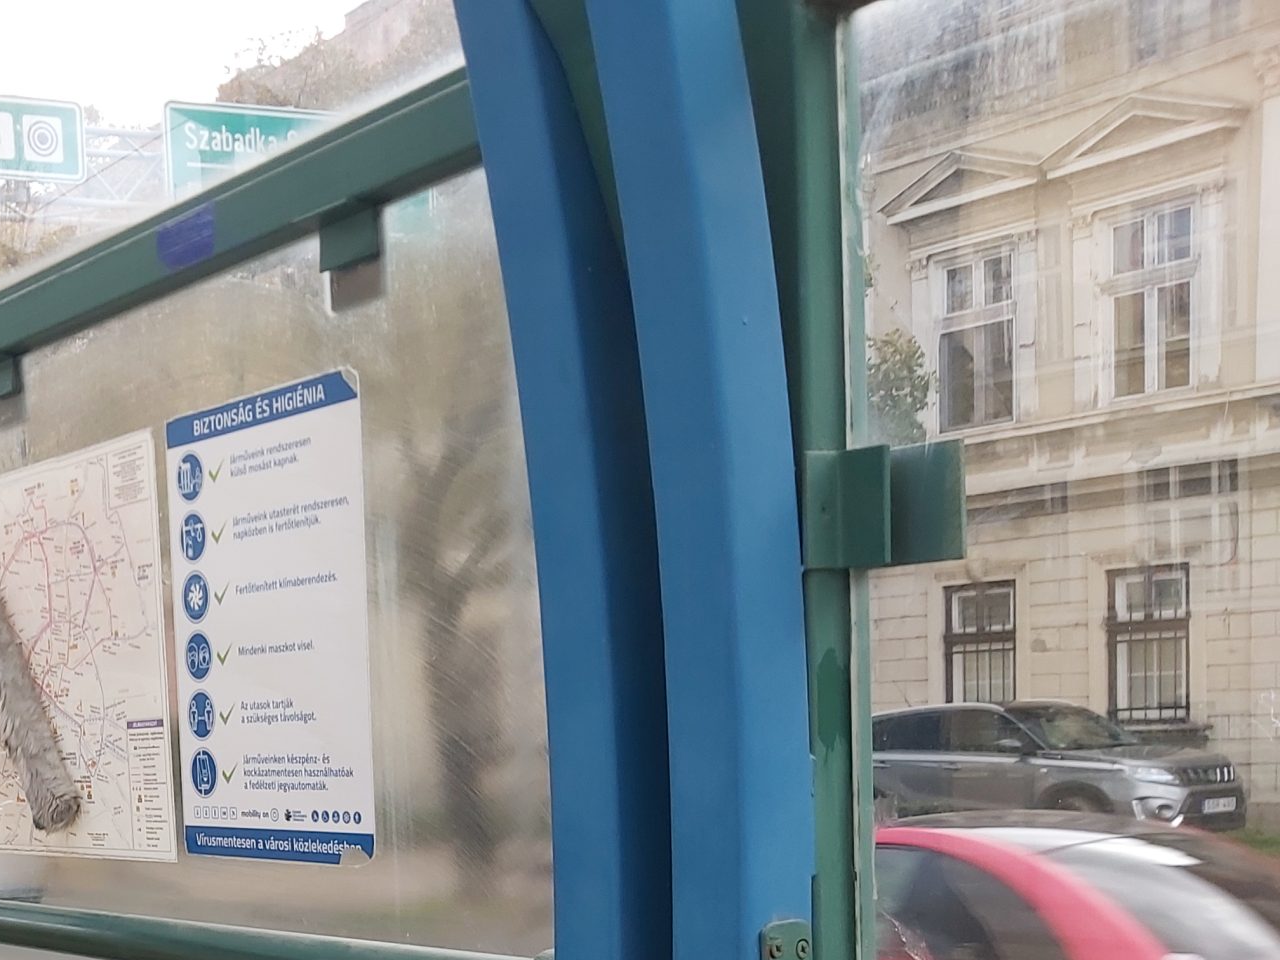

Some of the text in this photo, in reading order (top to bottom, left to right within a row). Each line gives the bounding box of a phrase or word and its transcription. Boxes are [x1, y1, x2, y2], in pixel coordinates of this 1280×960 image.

[193, 384, 325, 436] BIZTONSÁG ÉS HIGIÉNIA
[266, 437, 312, 456] rendszeresen
[233, 526, 267, 541] napközben
[238, 643, 268, 656] Mindenki
[268, 642, 296, 654] maszkot
[240, 697, 294, 712] Az utasok tartják
[246, 712, 279, 725] szükséges
[286, 753, 321, 766] készpénz-
[322, 753, 331, 765] és
[243, 766, 354, 778] kockázatmentesen használhatóak
[249, 779, 276, 791] fedélzeti
[196, 832, 256, 850] Vírusmentesen
[257, 839, 264, 850] a
[265, 836, 291, 851] városi
